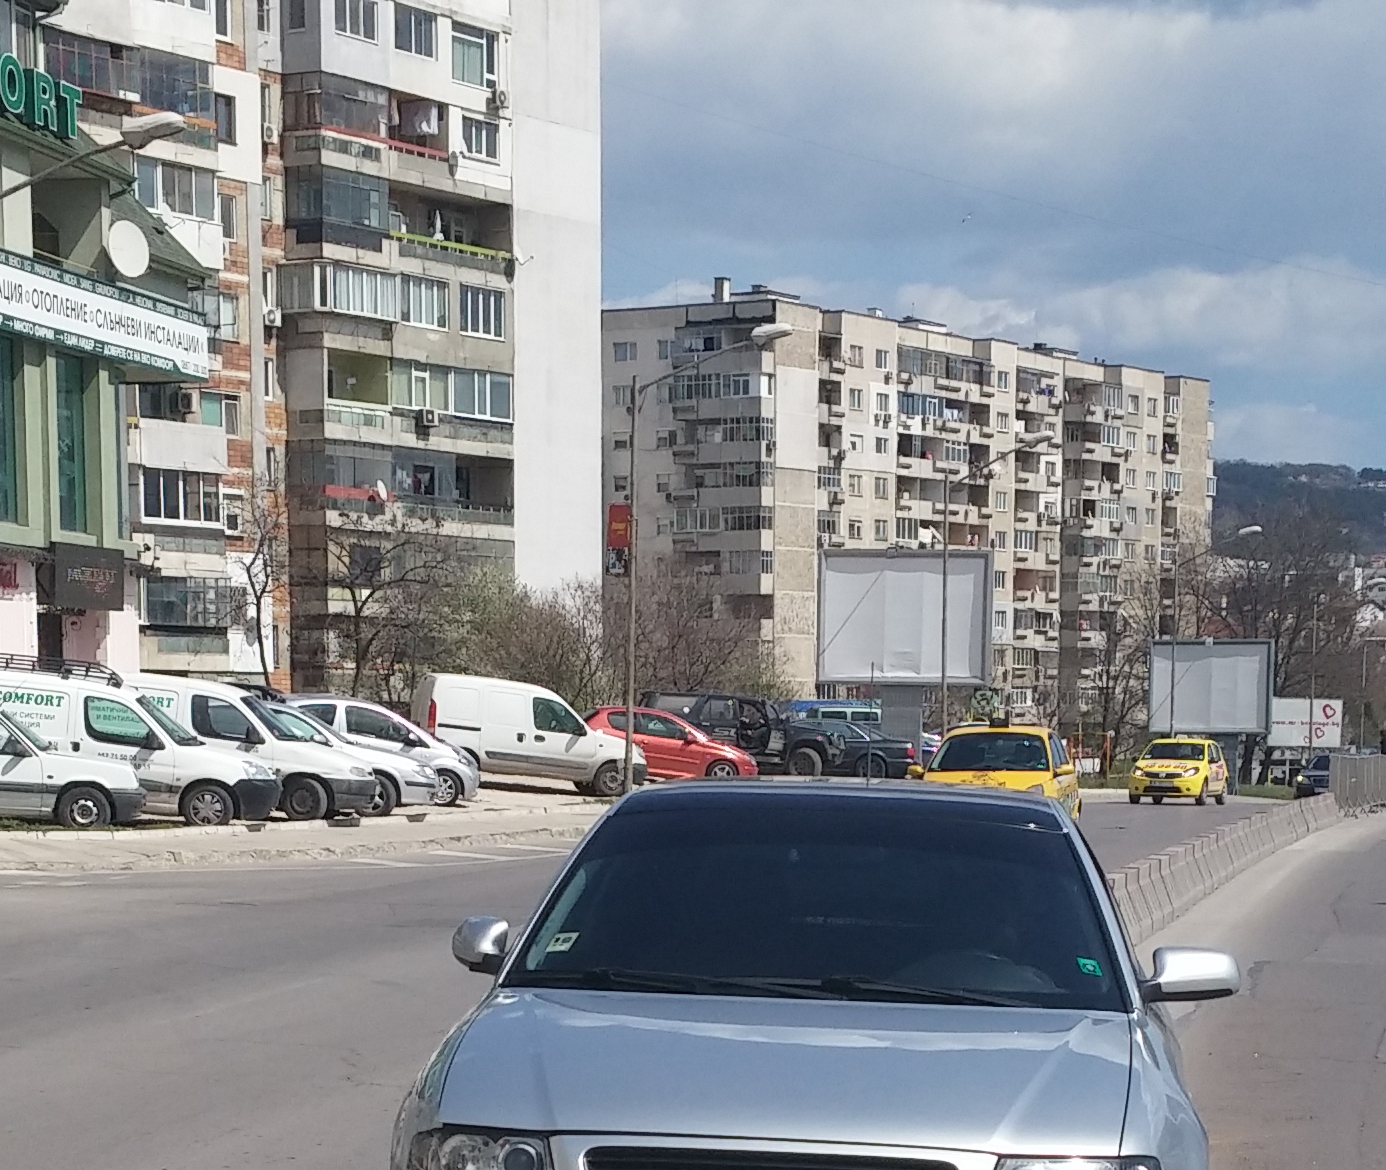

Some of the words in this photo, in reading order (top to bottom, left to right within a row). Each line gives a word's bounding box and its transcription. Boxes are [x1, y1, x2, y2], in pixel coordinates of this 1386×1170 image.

[31, 288, 88, 324] ОТОПЛЕНИЕ
[95, 308, 142, 340] СЛЪНЧЕВИ
[143, 320, 201, 356] ИНСТАЛАЦИИ
[19, 711, 56, 721] СИСТЕМИ
